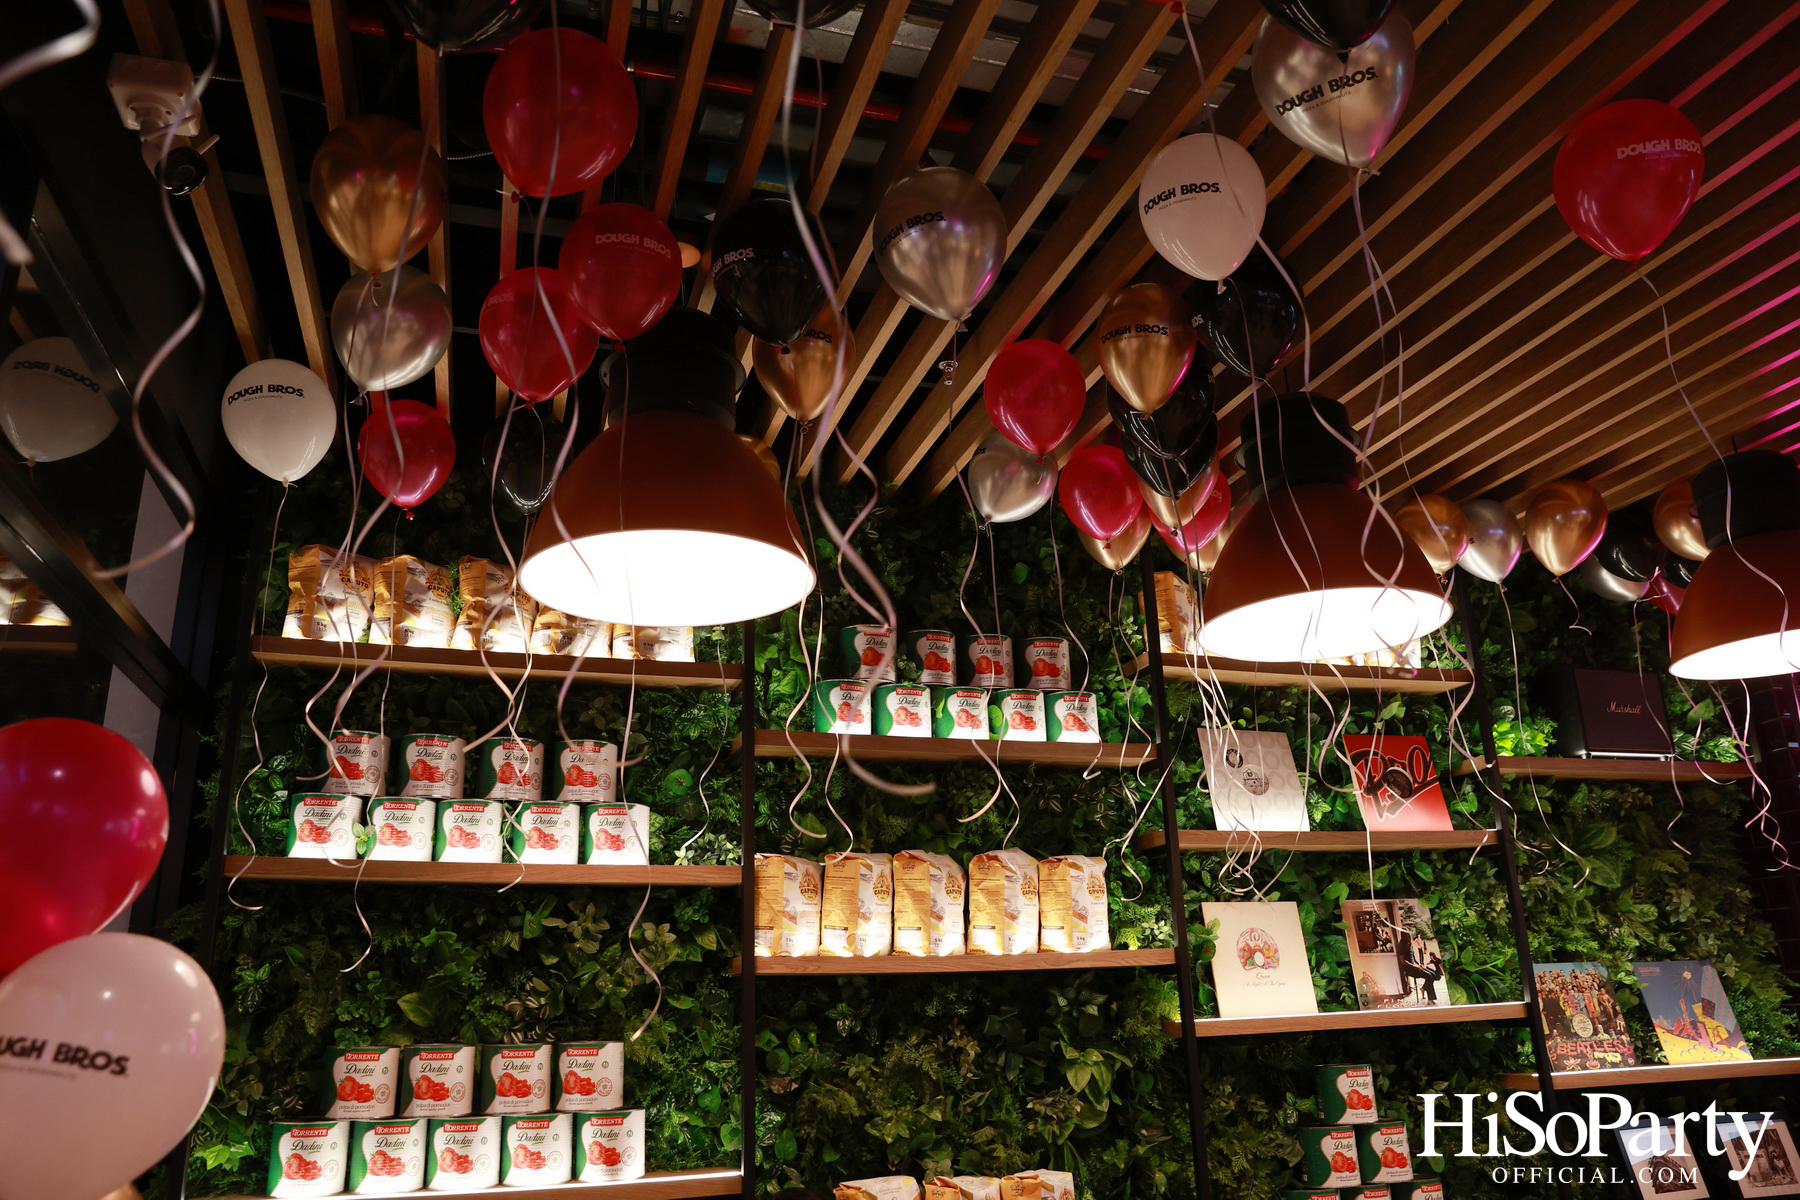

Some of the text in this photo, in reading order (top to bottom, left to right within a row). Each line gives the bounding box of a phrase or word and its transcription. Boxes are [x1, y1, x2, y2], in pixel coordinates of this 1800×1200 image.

[1275, 85, 1325, 116] DOUGH
[1616, 138, 1702, 160] DOUGH BROS
[1143, 187, 1176, 216] DOUGH
[595, 233, 640, 245] DOUGH
[1102, 326, 1131, 344] DOUGH
[227, 384, 264, 406] DOUGH
[1606, 700, 1642, 714] Marshall
[1557, 1040, 1626, 1056] BEATLES
[344, 1063, 377, 1075] Dadini
[419, 1062, 451, 1074] Dadini
[502, 1060, 532, 1071] Dadini
[567, 1058, 596, 1069] Dadini
[516, 1131, 546, 1142] Dadini
[591, 1128, 621, 1139] Dadini
[290, 1139, 324, 1151] Dadini
[375, 1136, 407, 1148] Dadini
[444, 1134, 475, 1146] Dadini
